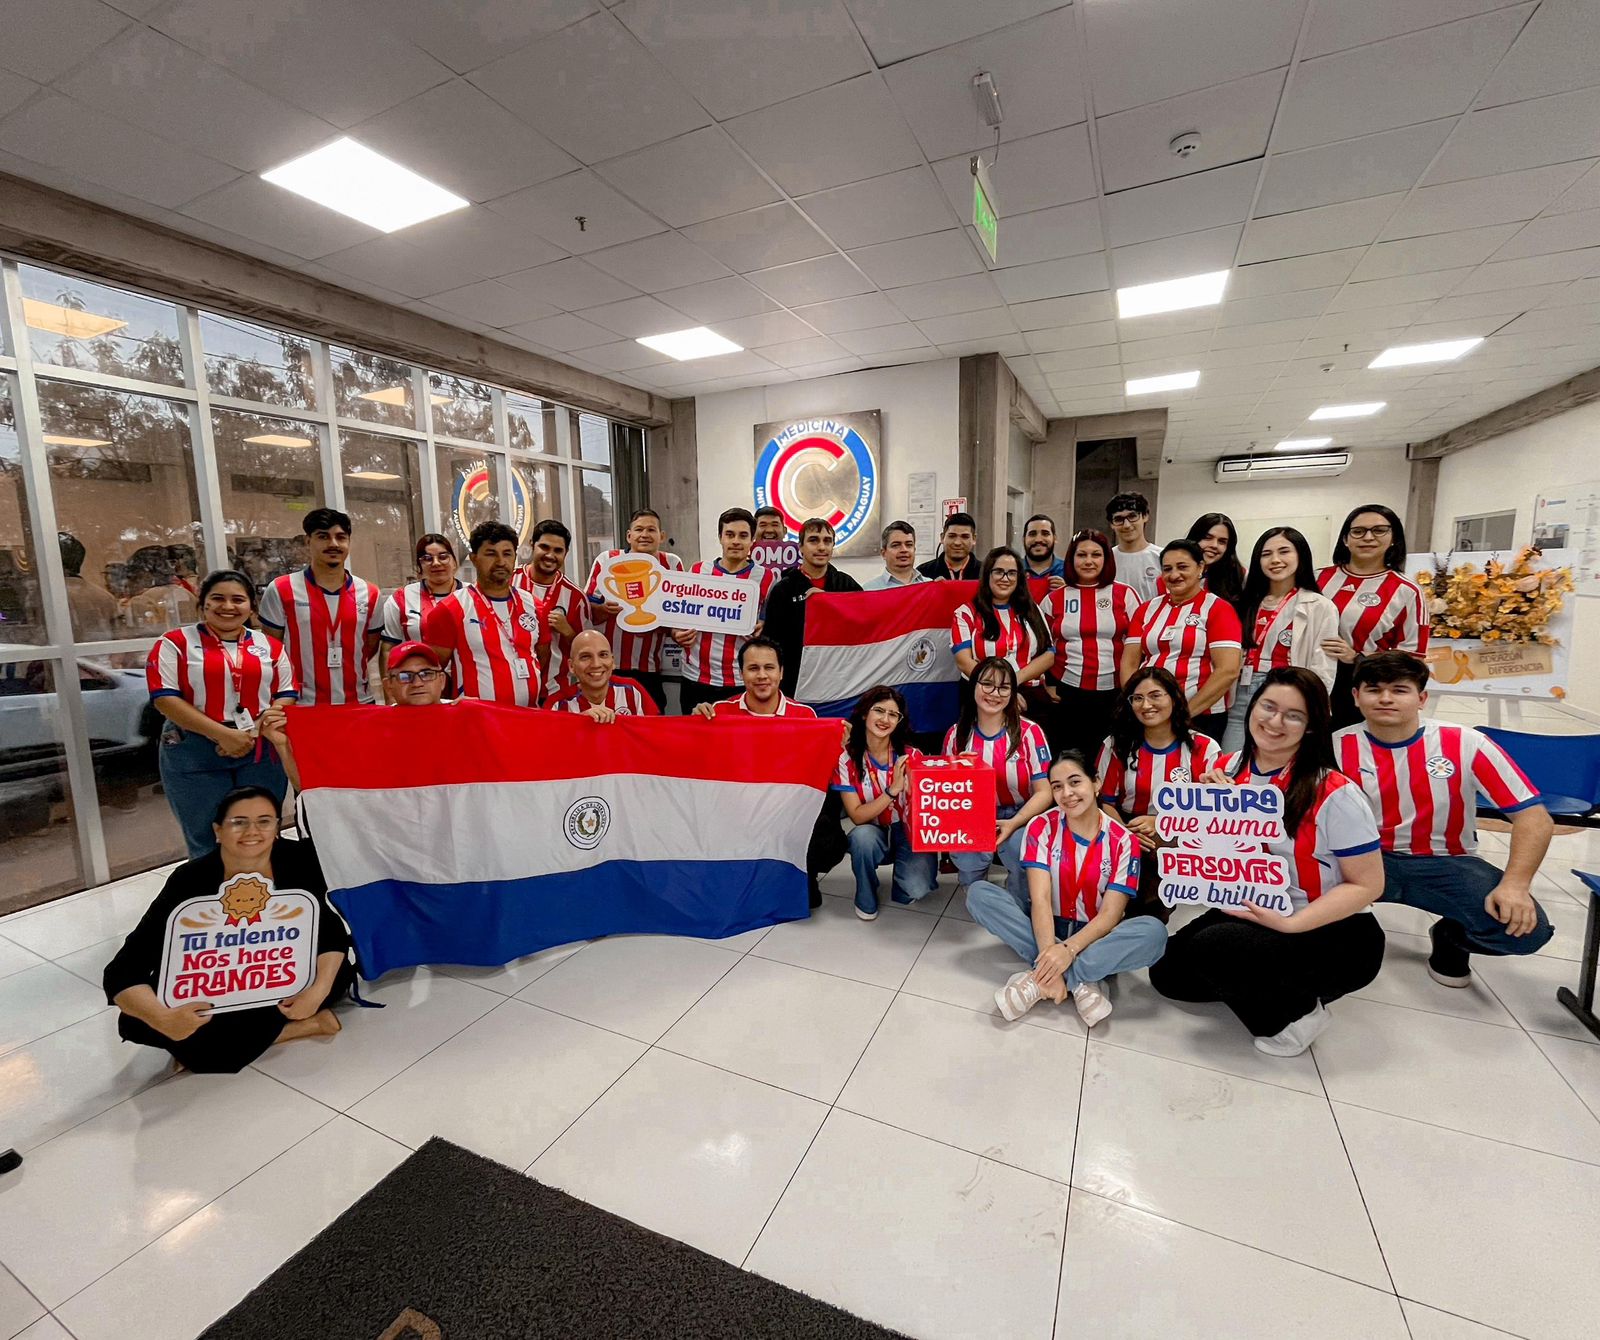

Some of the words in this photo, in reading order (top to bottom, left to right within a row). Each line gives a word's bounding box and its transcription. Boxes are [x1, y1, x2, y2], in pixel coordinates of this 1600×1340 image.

[778, 421, 845, 445] MEDICINA
[847, 476, 871, 531] PARAGUAY
[662, 580, 728, 600] Orgullosos
[731, 588, 747, 602] de
[662, 599, 703, 616] estar
[707, 604, 742, 622] aquí
[1065, 599, 1079, 613] 10
[919, 778, 973, 793] Great
[920, 795, 972, 810] Place
[1157, 786, 1278, 814] CULTURA
[919, 812, 941, 827] To
[1159, 815, 1199, 837] que
[1206, 816, 1280, 838] suma
[919, 829, 973, 844] Work.
[1162, 852, 1284, 886] PERSONAS
[1163, 882, 1199, 903] que
[1207, 881, 1287, 911] brillan
[215, 925, 300, 948] talento
[181, 949, 230, 972] Nos
[238, 946, 293, 965] hace
[172, 961, 297, 1000] GRANDES
